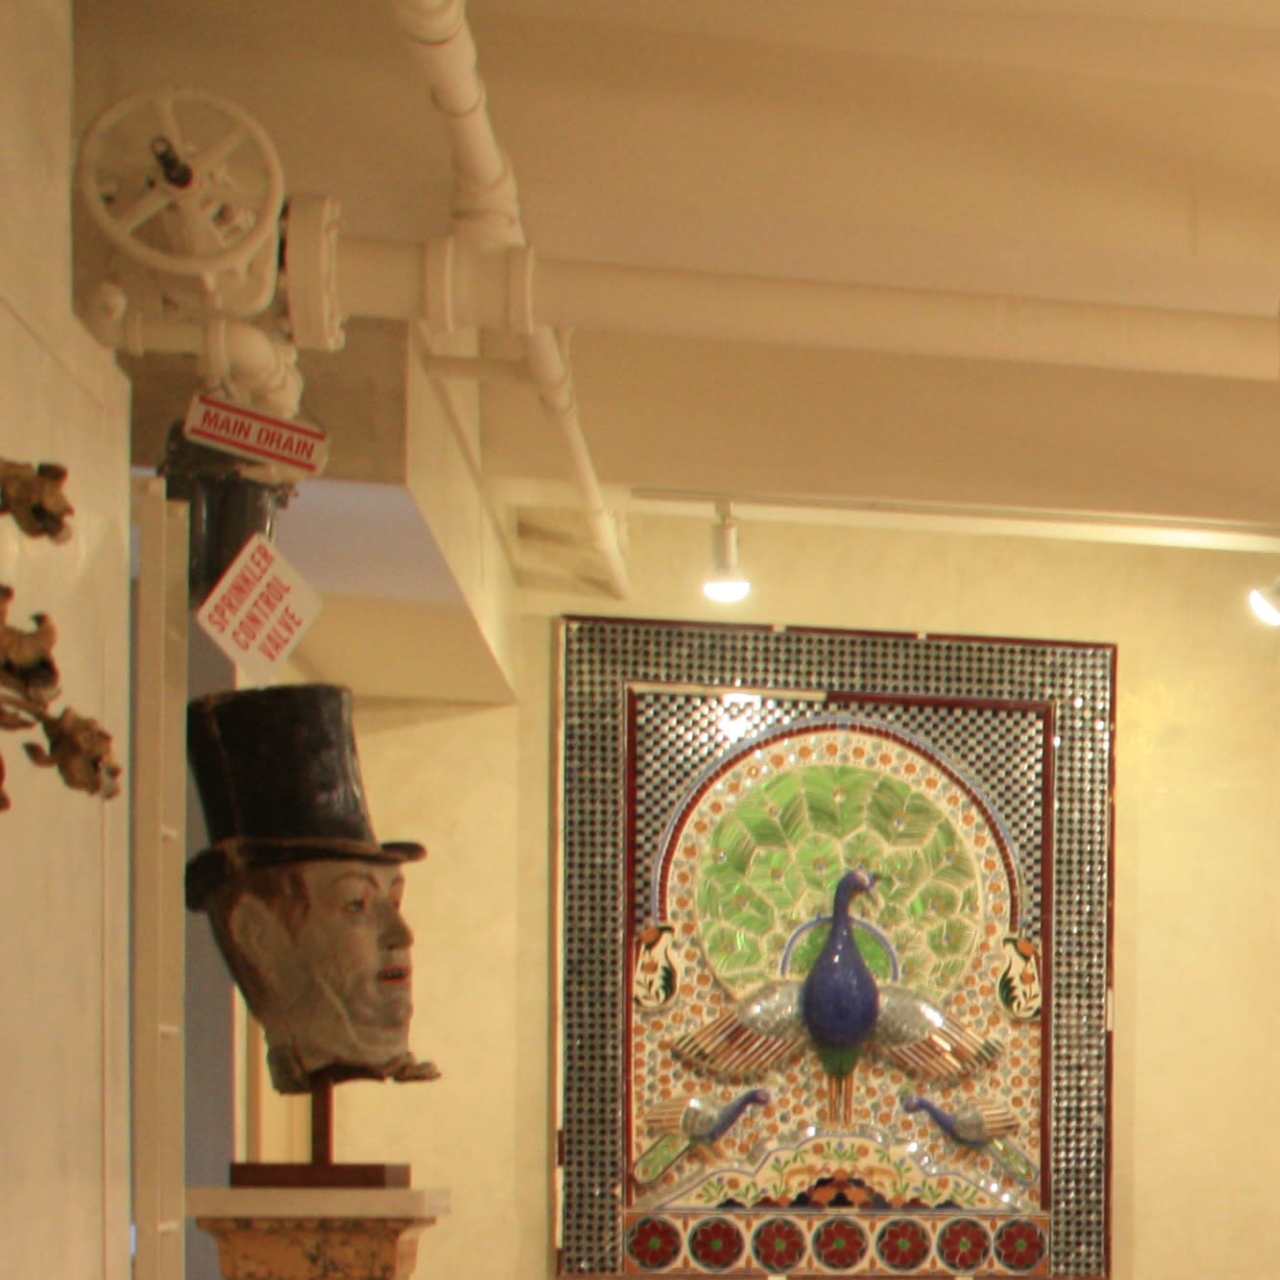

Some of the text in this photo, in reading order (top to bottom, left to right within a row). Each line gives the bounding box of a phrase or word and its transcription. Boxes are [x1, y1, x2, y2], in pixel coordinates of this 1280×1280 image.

[202, 410, 315, 460] MAIN DRAIN
[207, 544, 274, 633] SPRINKLER
[232, 576, 291, 652] CONTROL
[259, 605, 304, 662] VALVE
